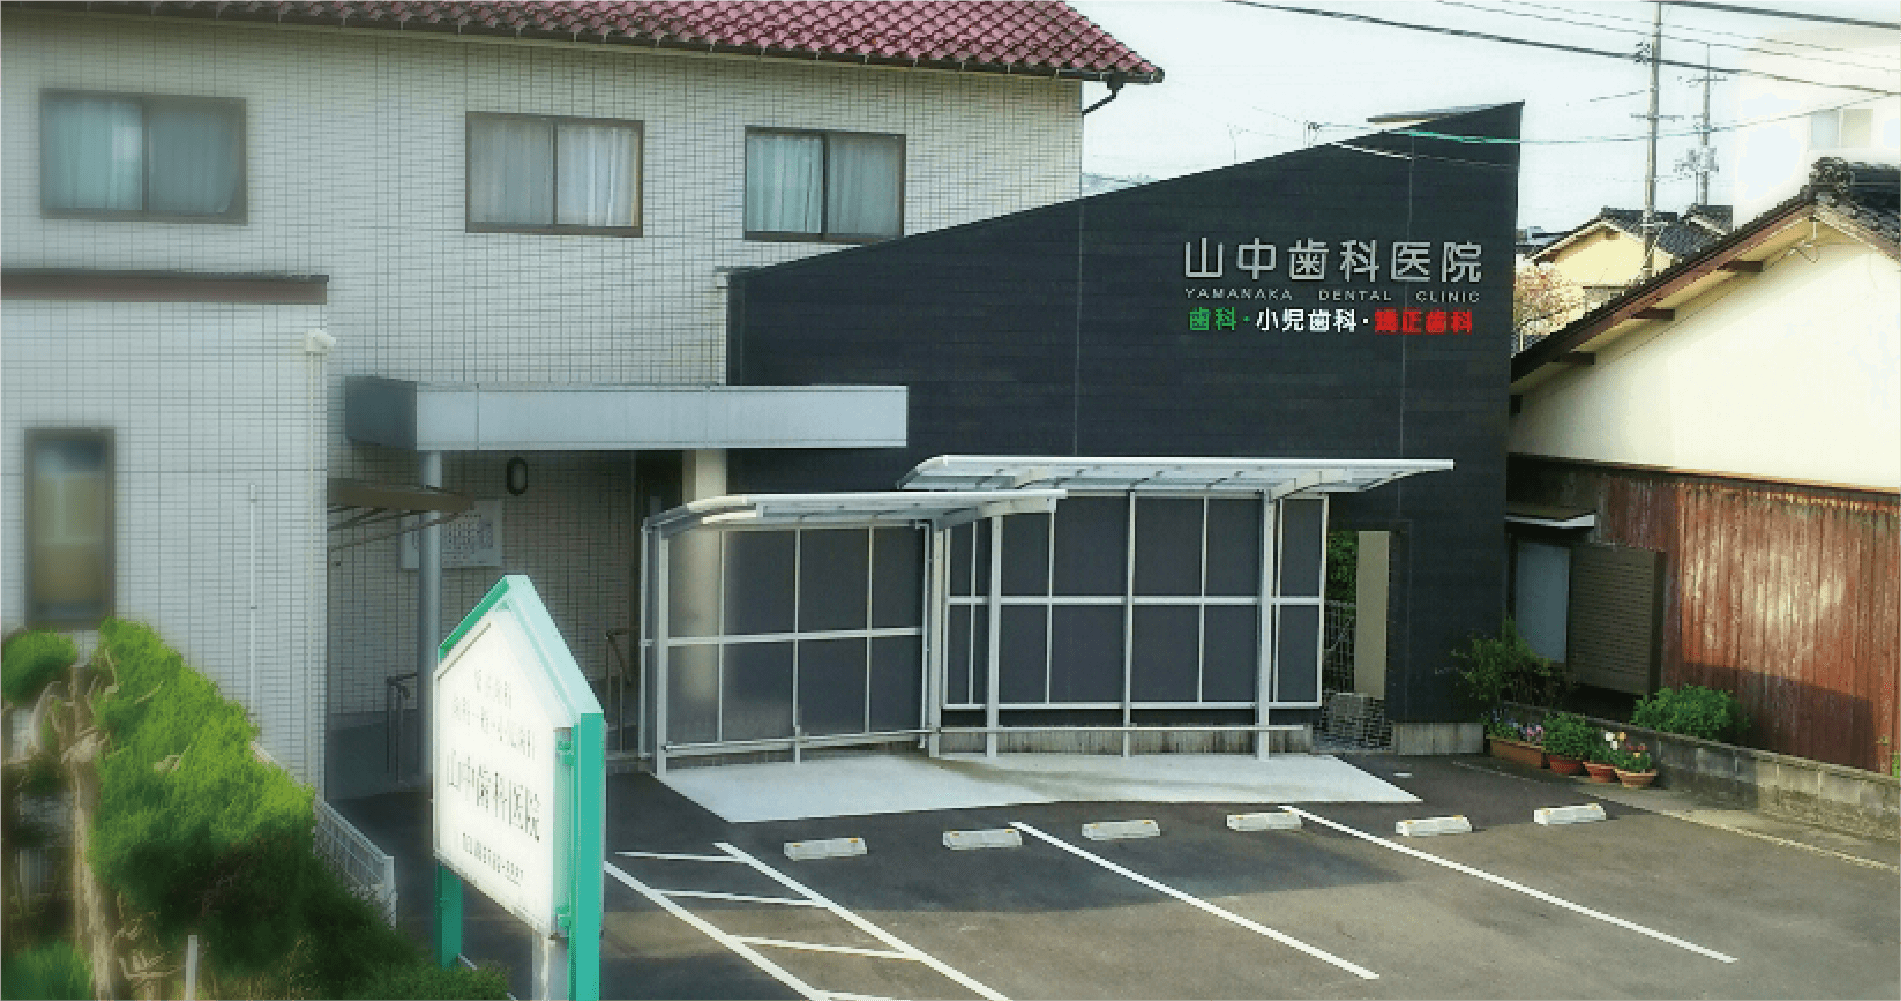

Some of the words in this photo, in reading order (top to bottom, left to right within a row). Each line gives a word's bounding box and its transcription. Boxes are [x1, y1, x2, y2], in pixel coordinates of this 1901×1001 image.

[1185, 237, 1482, 283] 山中歯科医院
[1185, 288, 1293, 300] YAMANAKA
[1318, 289, 1392, 301] DENTAL
[1415, 290, 1480, 302] CLINIC
